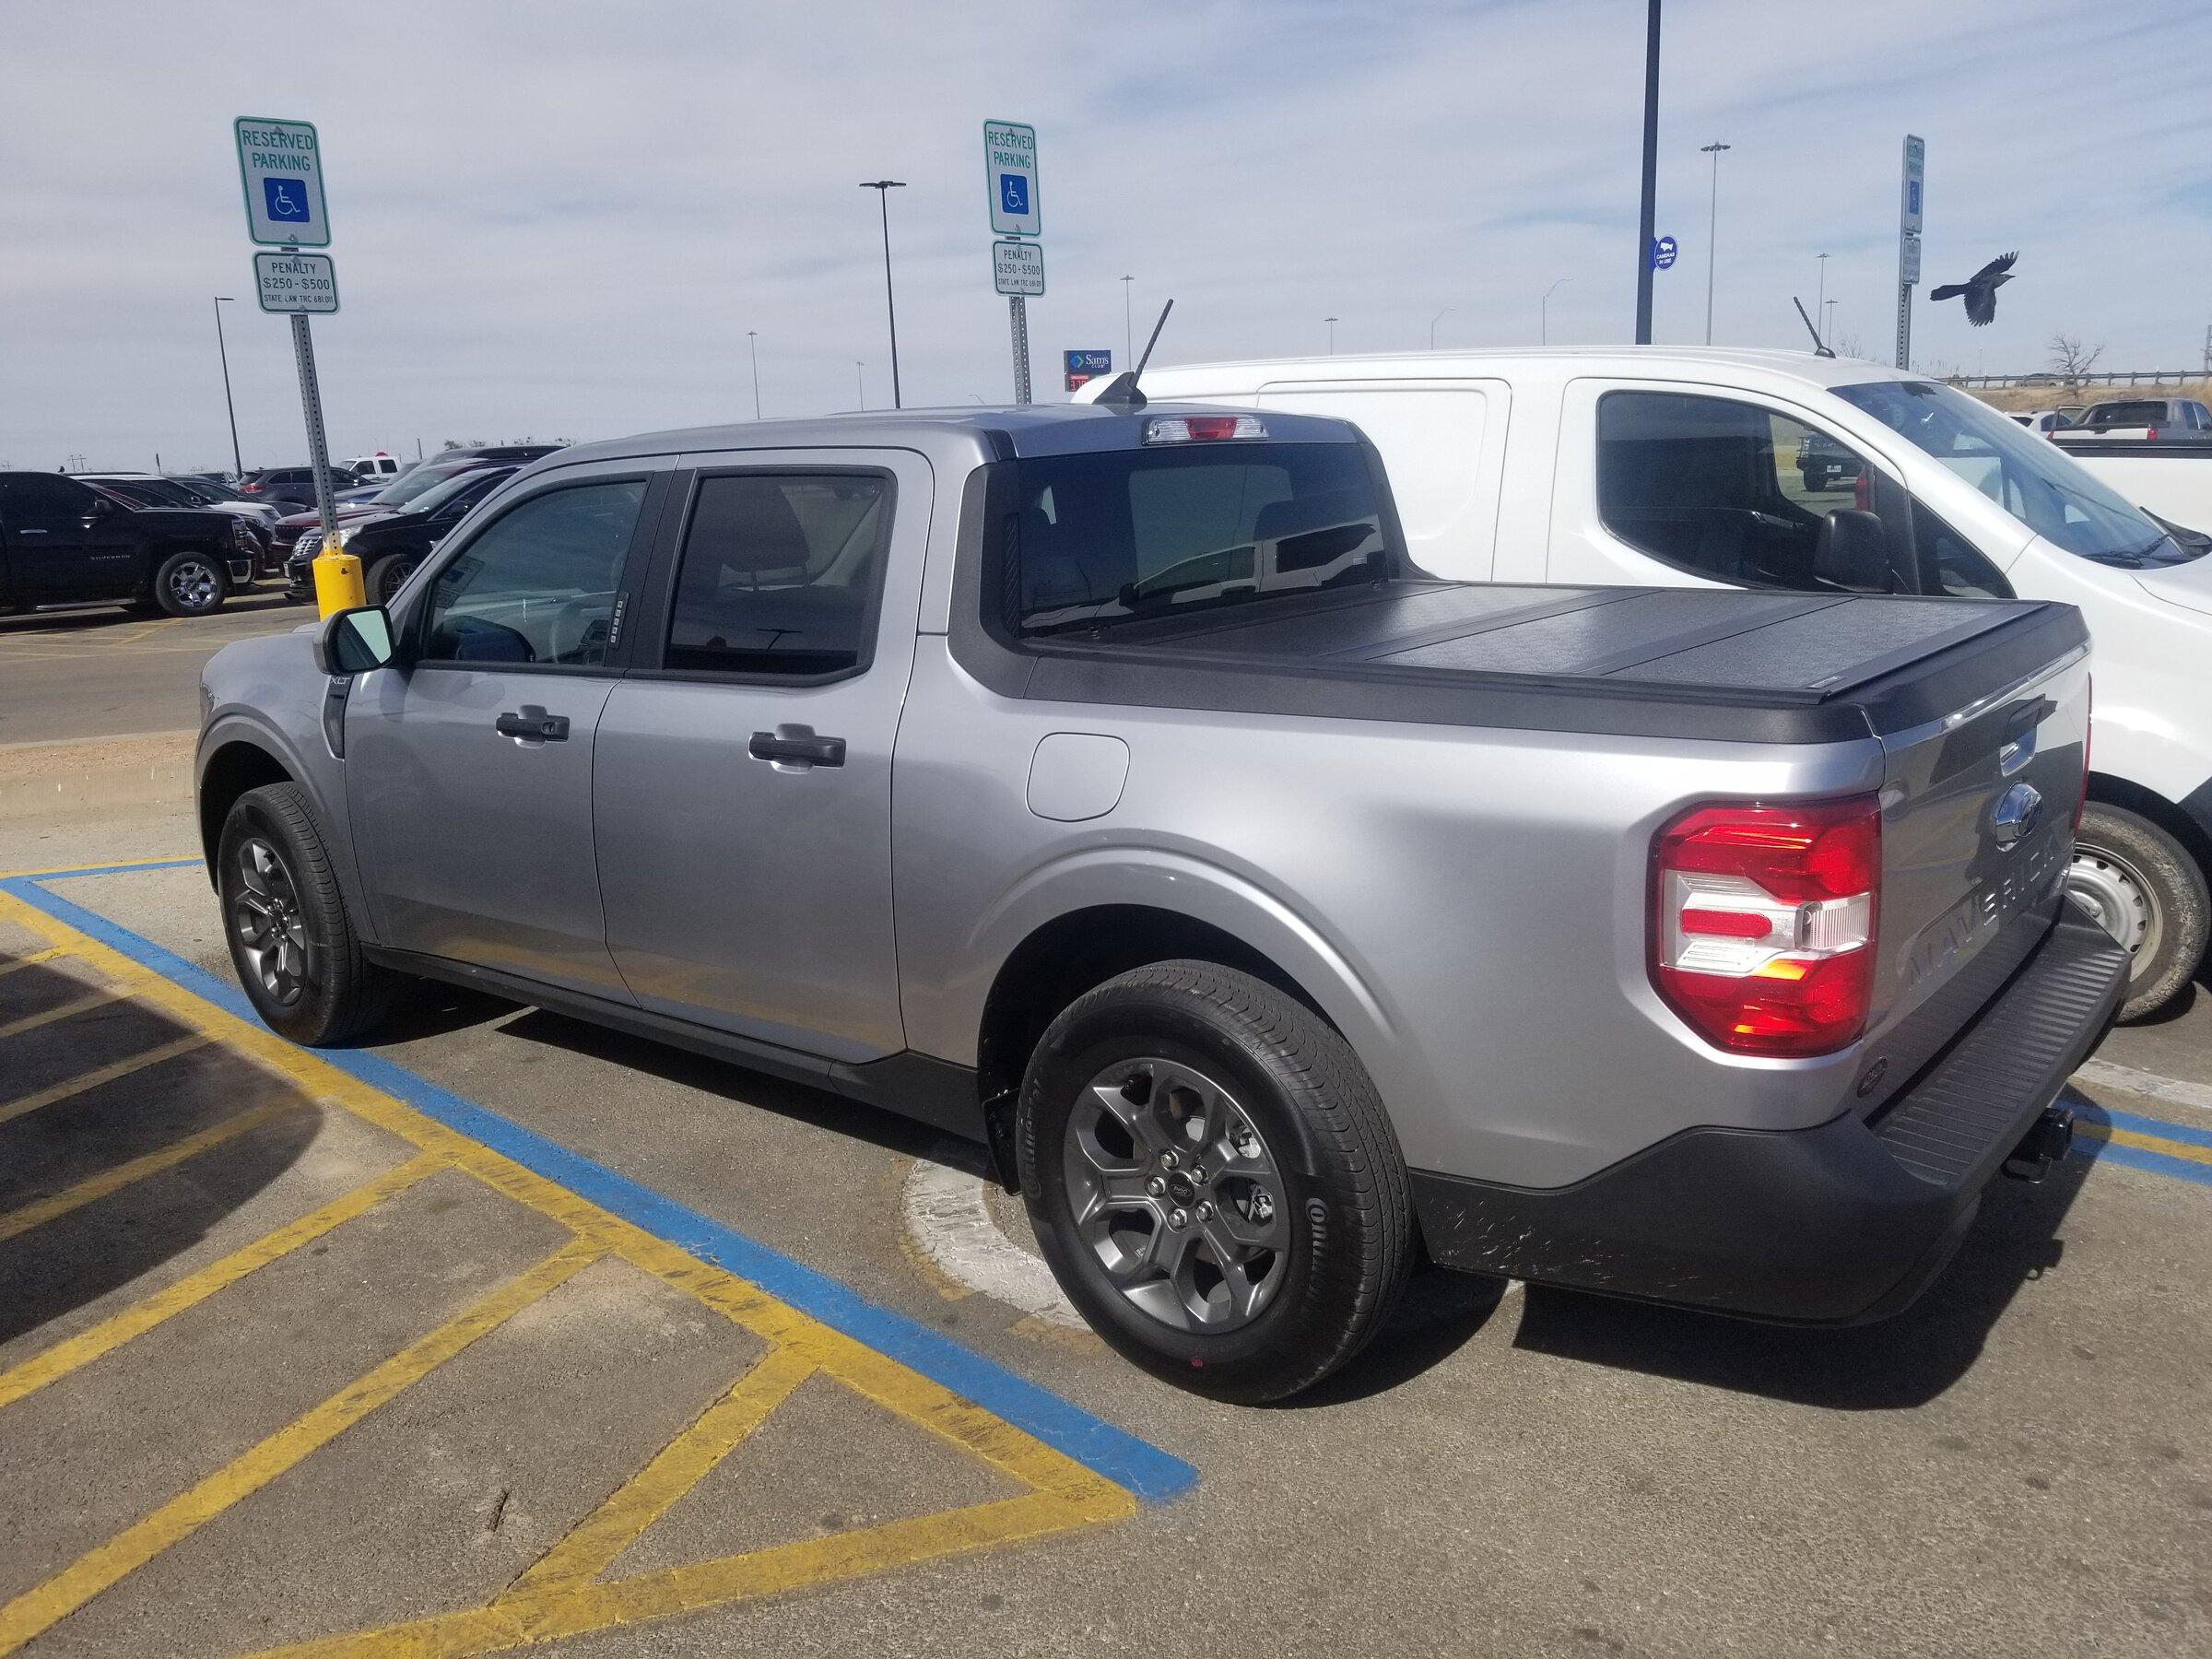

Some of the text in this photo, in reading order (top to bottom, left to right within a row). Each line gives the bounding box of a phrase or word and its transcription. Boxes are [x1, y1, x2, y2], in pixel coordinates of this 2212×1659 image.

[241, 129, 313, 150] RESERVED
[988, 131, 1033, 150] RESERVED
[252, 152, 311, 171] PARKING
[994, 150, 1030, 169] PARKING
[1003, 249, 1031, 261] PENALTY
[271, 262, 316, 275] PENALTY
[265, 294, 282, 303] STATE
[285, 295, 297, 303] LAW
[300, 295, 312, 303] TRC
[331, 677, 350, 685] XLT
